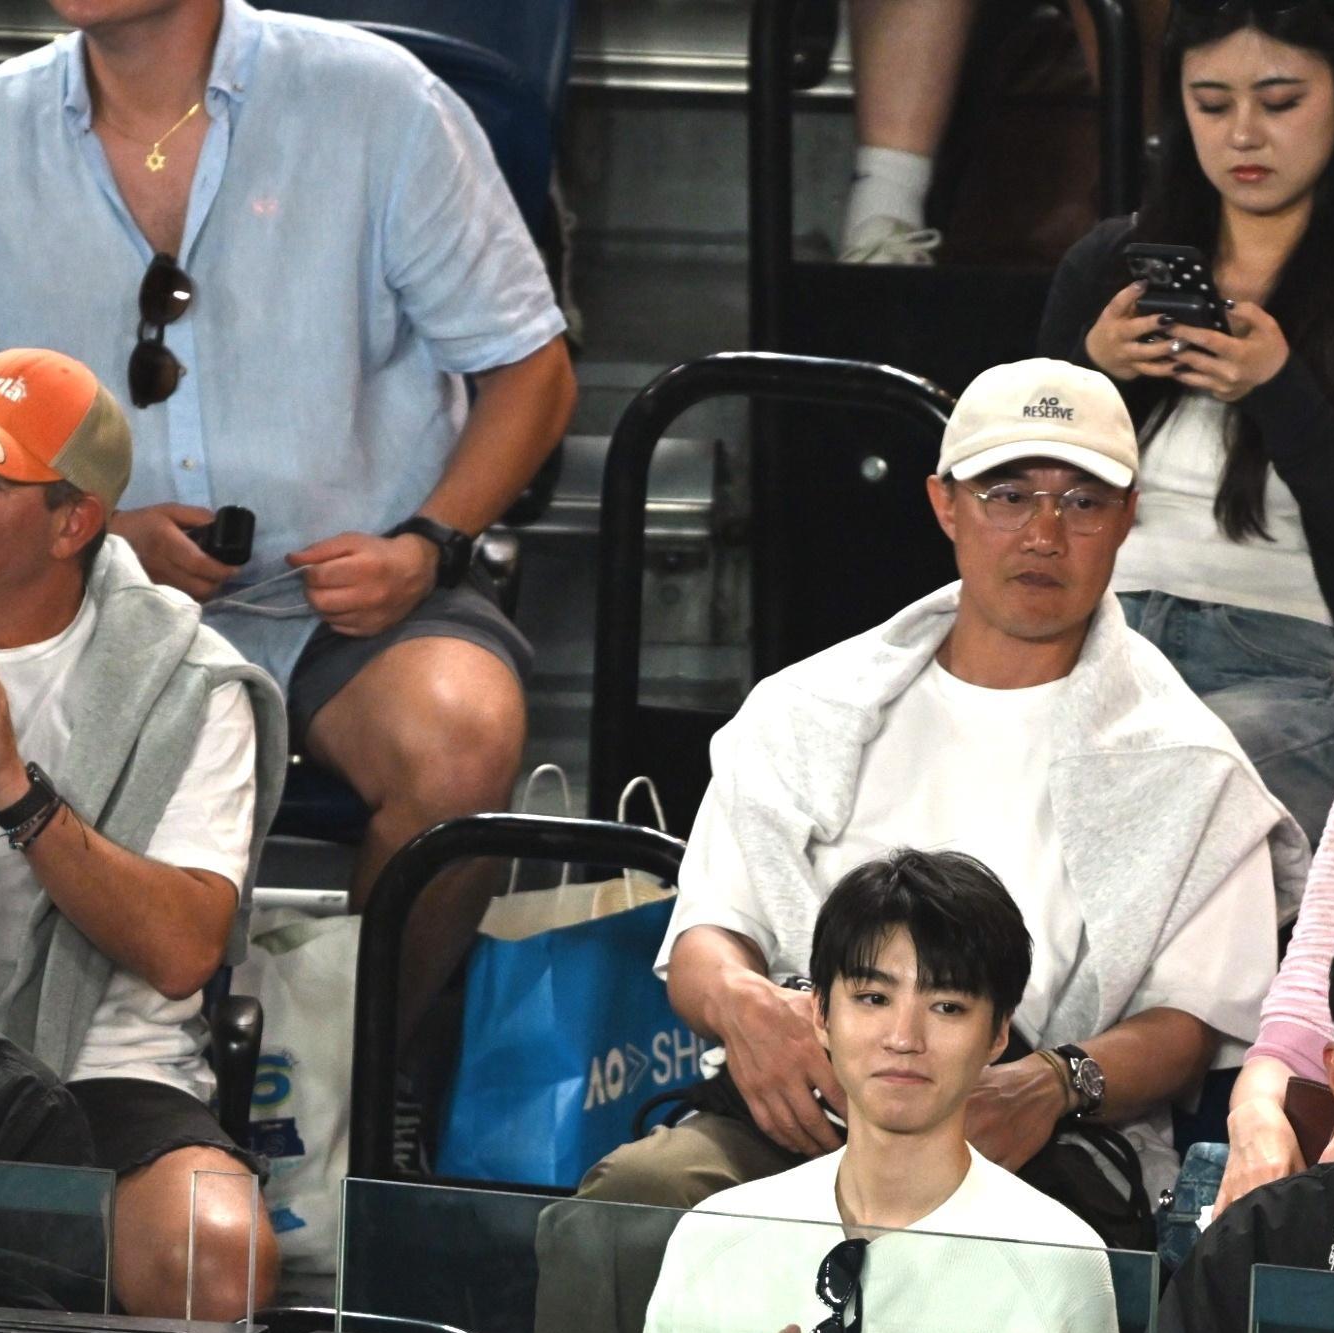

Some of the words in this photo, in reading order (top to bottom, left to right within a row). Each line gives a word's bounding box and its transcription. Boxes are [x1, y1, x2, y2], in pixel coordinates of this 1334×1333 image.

[1039, 397, 1059, 406] AO
[1023, 406, 1074, 420] RESERVE
[652, 1028, 707, 1085] SH
